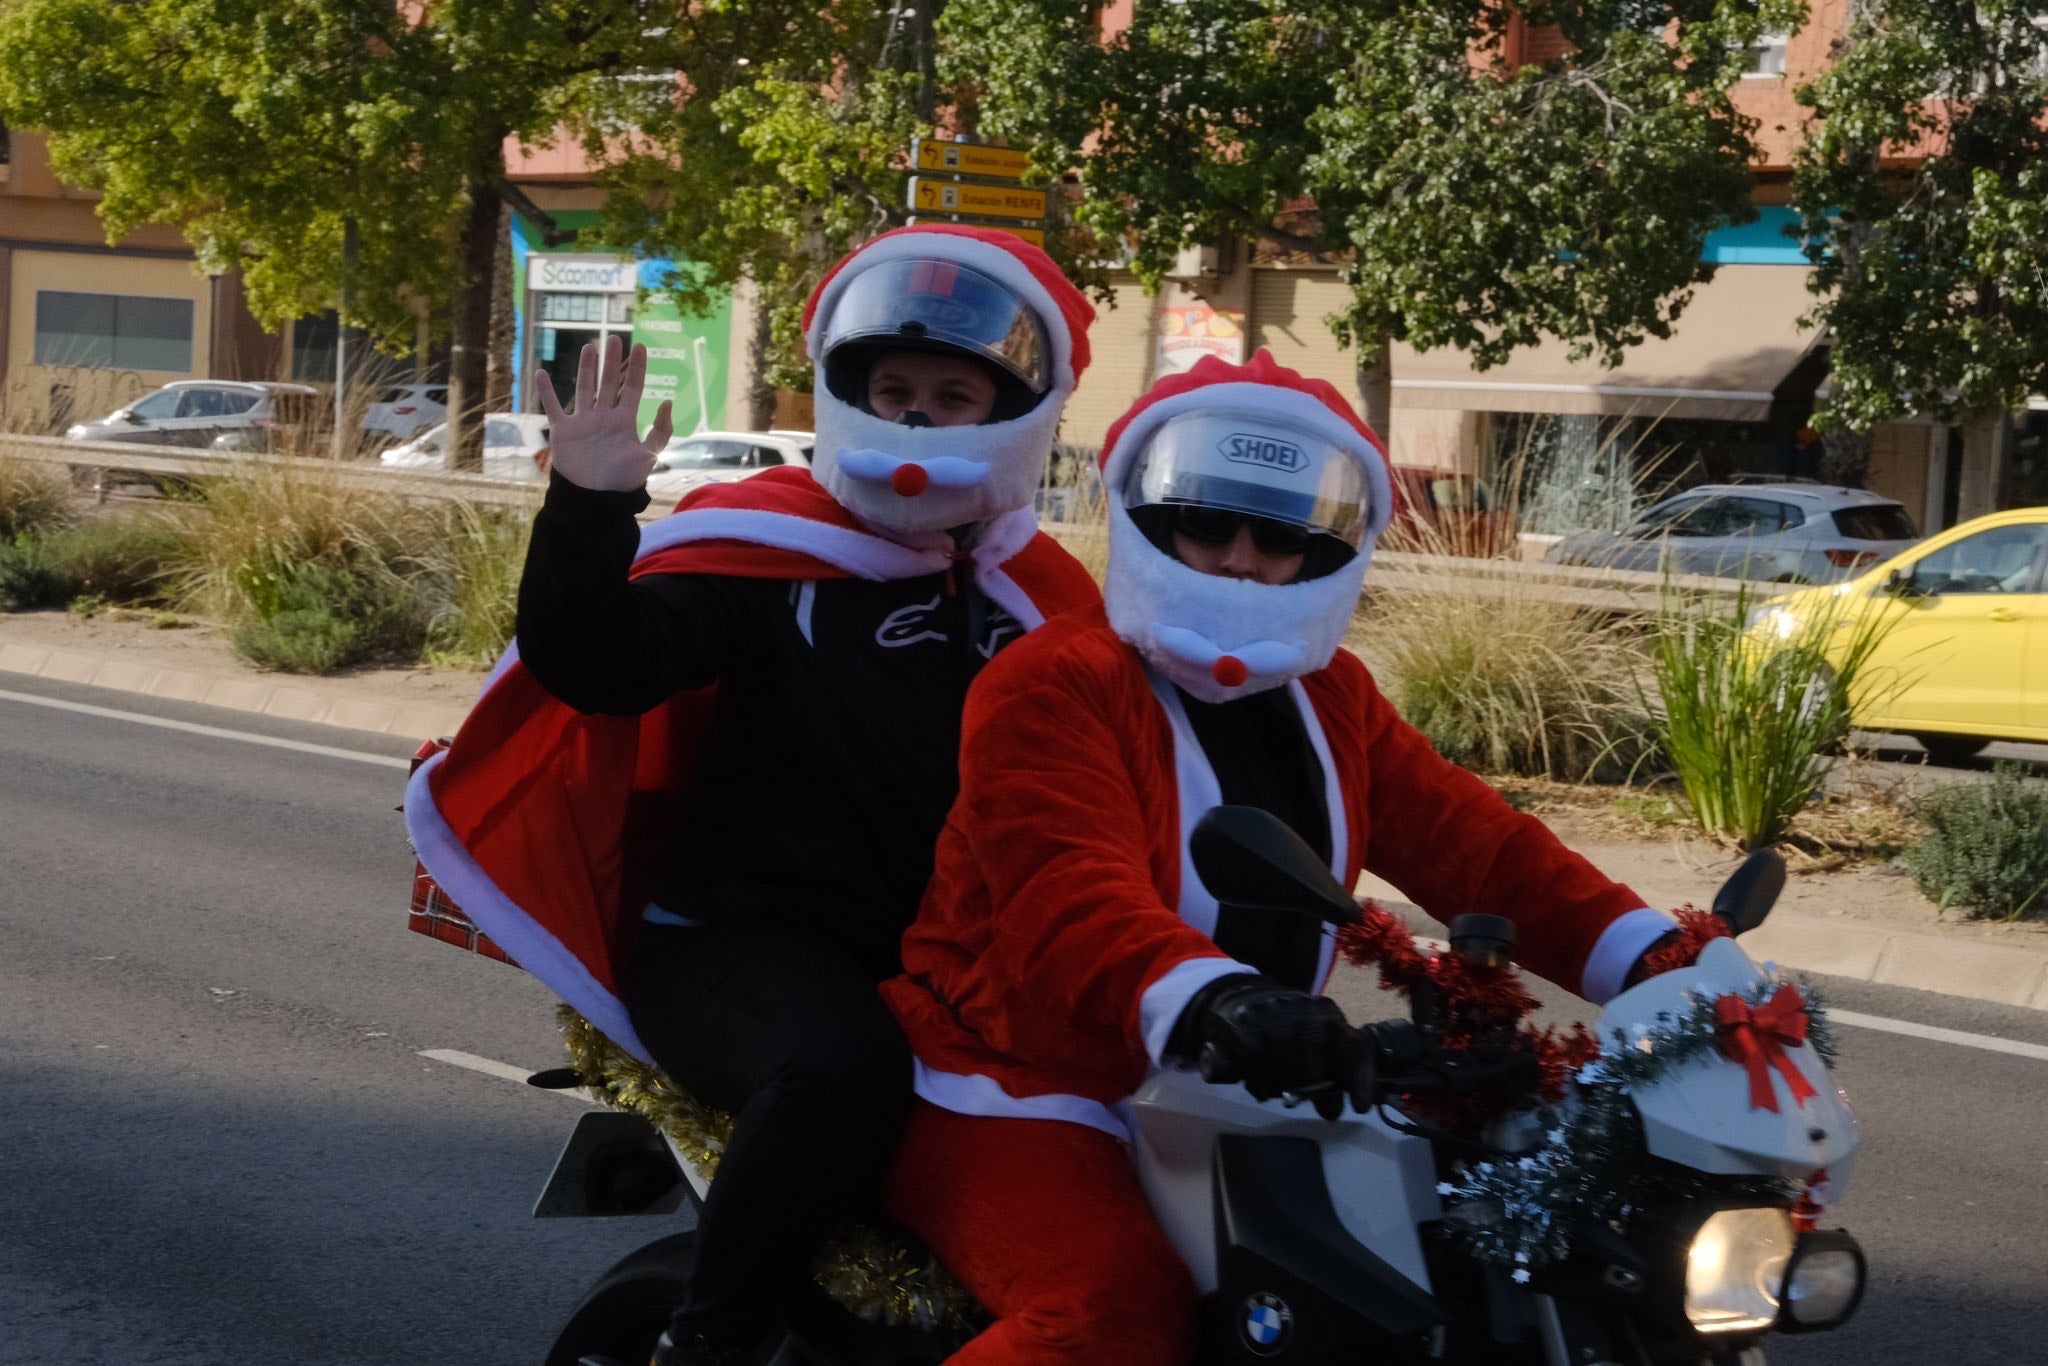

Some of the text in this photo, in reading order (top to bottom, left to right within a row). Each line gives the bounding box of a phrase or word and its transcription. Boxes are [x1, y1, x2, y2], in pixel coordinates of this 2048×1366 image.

[1005, 195, 1042, 211] RENFE
[543, 261, 622, 285] Scoomart
[1229, 438, 1297, 468] SHOEI
